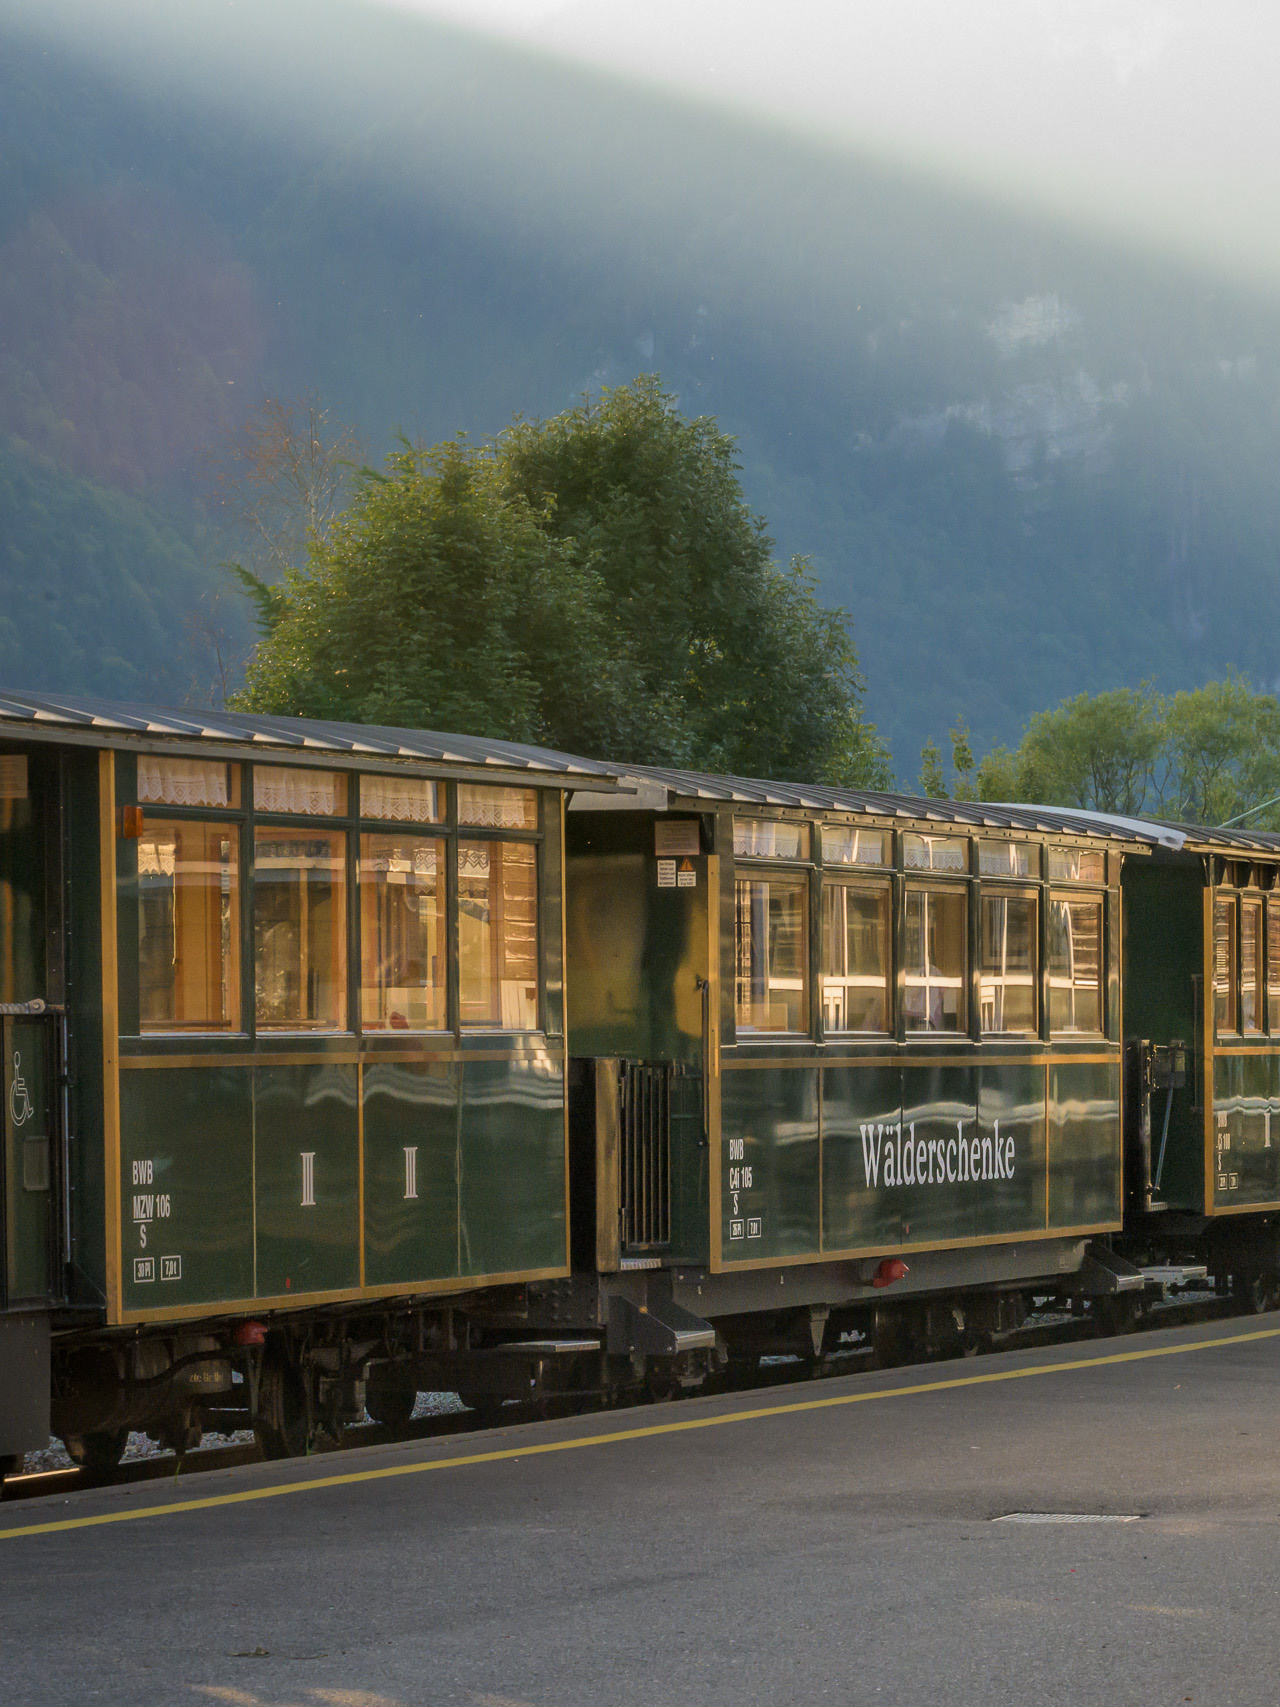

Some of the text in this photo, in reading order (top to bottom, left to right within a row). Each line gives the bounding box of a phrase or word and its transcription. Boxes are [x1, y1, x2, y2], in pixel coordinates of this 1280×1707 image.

[730, 1139, 744, 1160] BWB
[859, 1119, 1015, 1188] Wälderschenke
[132, 1160, 153, 1185] BWB
[741, 1166, 753, 1188] 105
[133, 1194, 171, 1219] MZW 106
[733, 1193, 739, 1216] S
[140, 1224, 147, 1248] S
